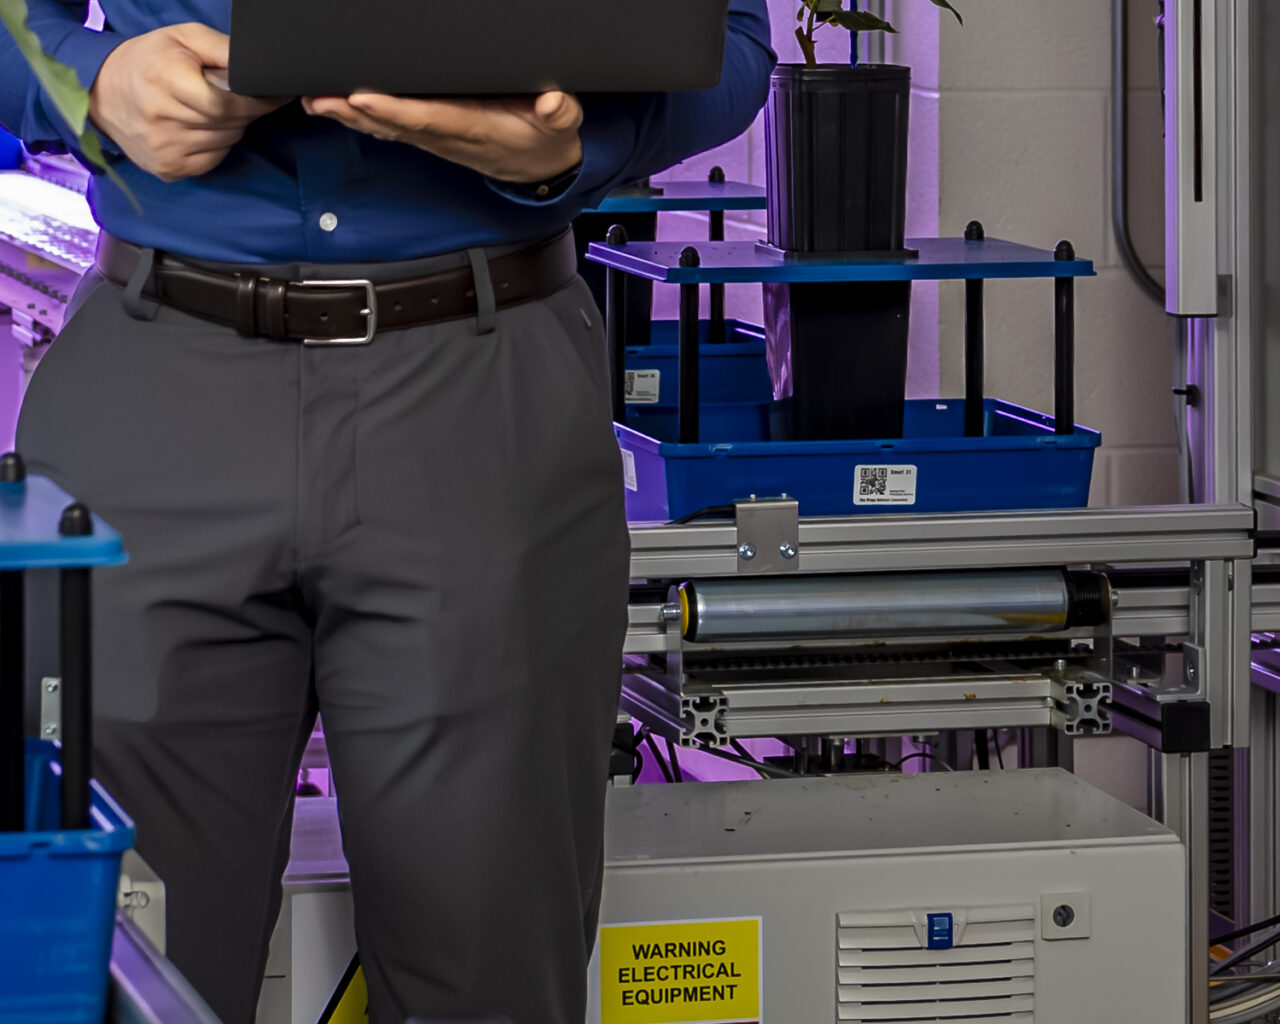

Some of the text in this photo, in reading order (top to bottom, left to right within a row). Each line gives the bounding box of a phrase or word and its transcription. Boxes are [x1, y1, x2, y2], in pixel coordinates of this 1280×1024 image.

[632, 940, 726, 960] WARNING
[618, 962, 741, 983] ELECTRICAL
[622, 984, 738, 1006] EQUIPMENT
